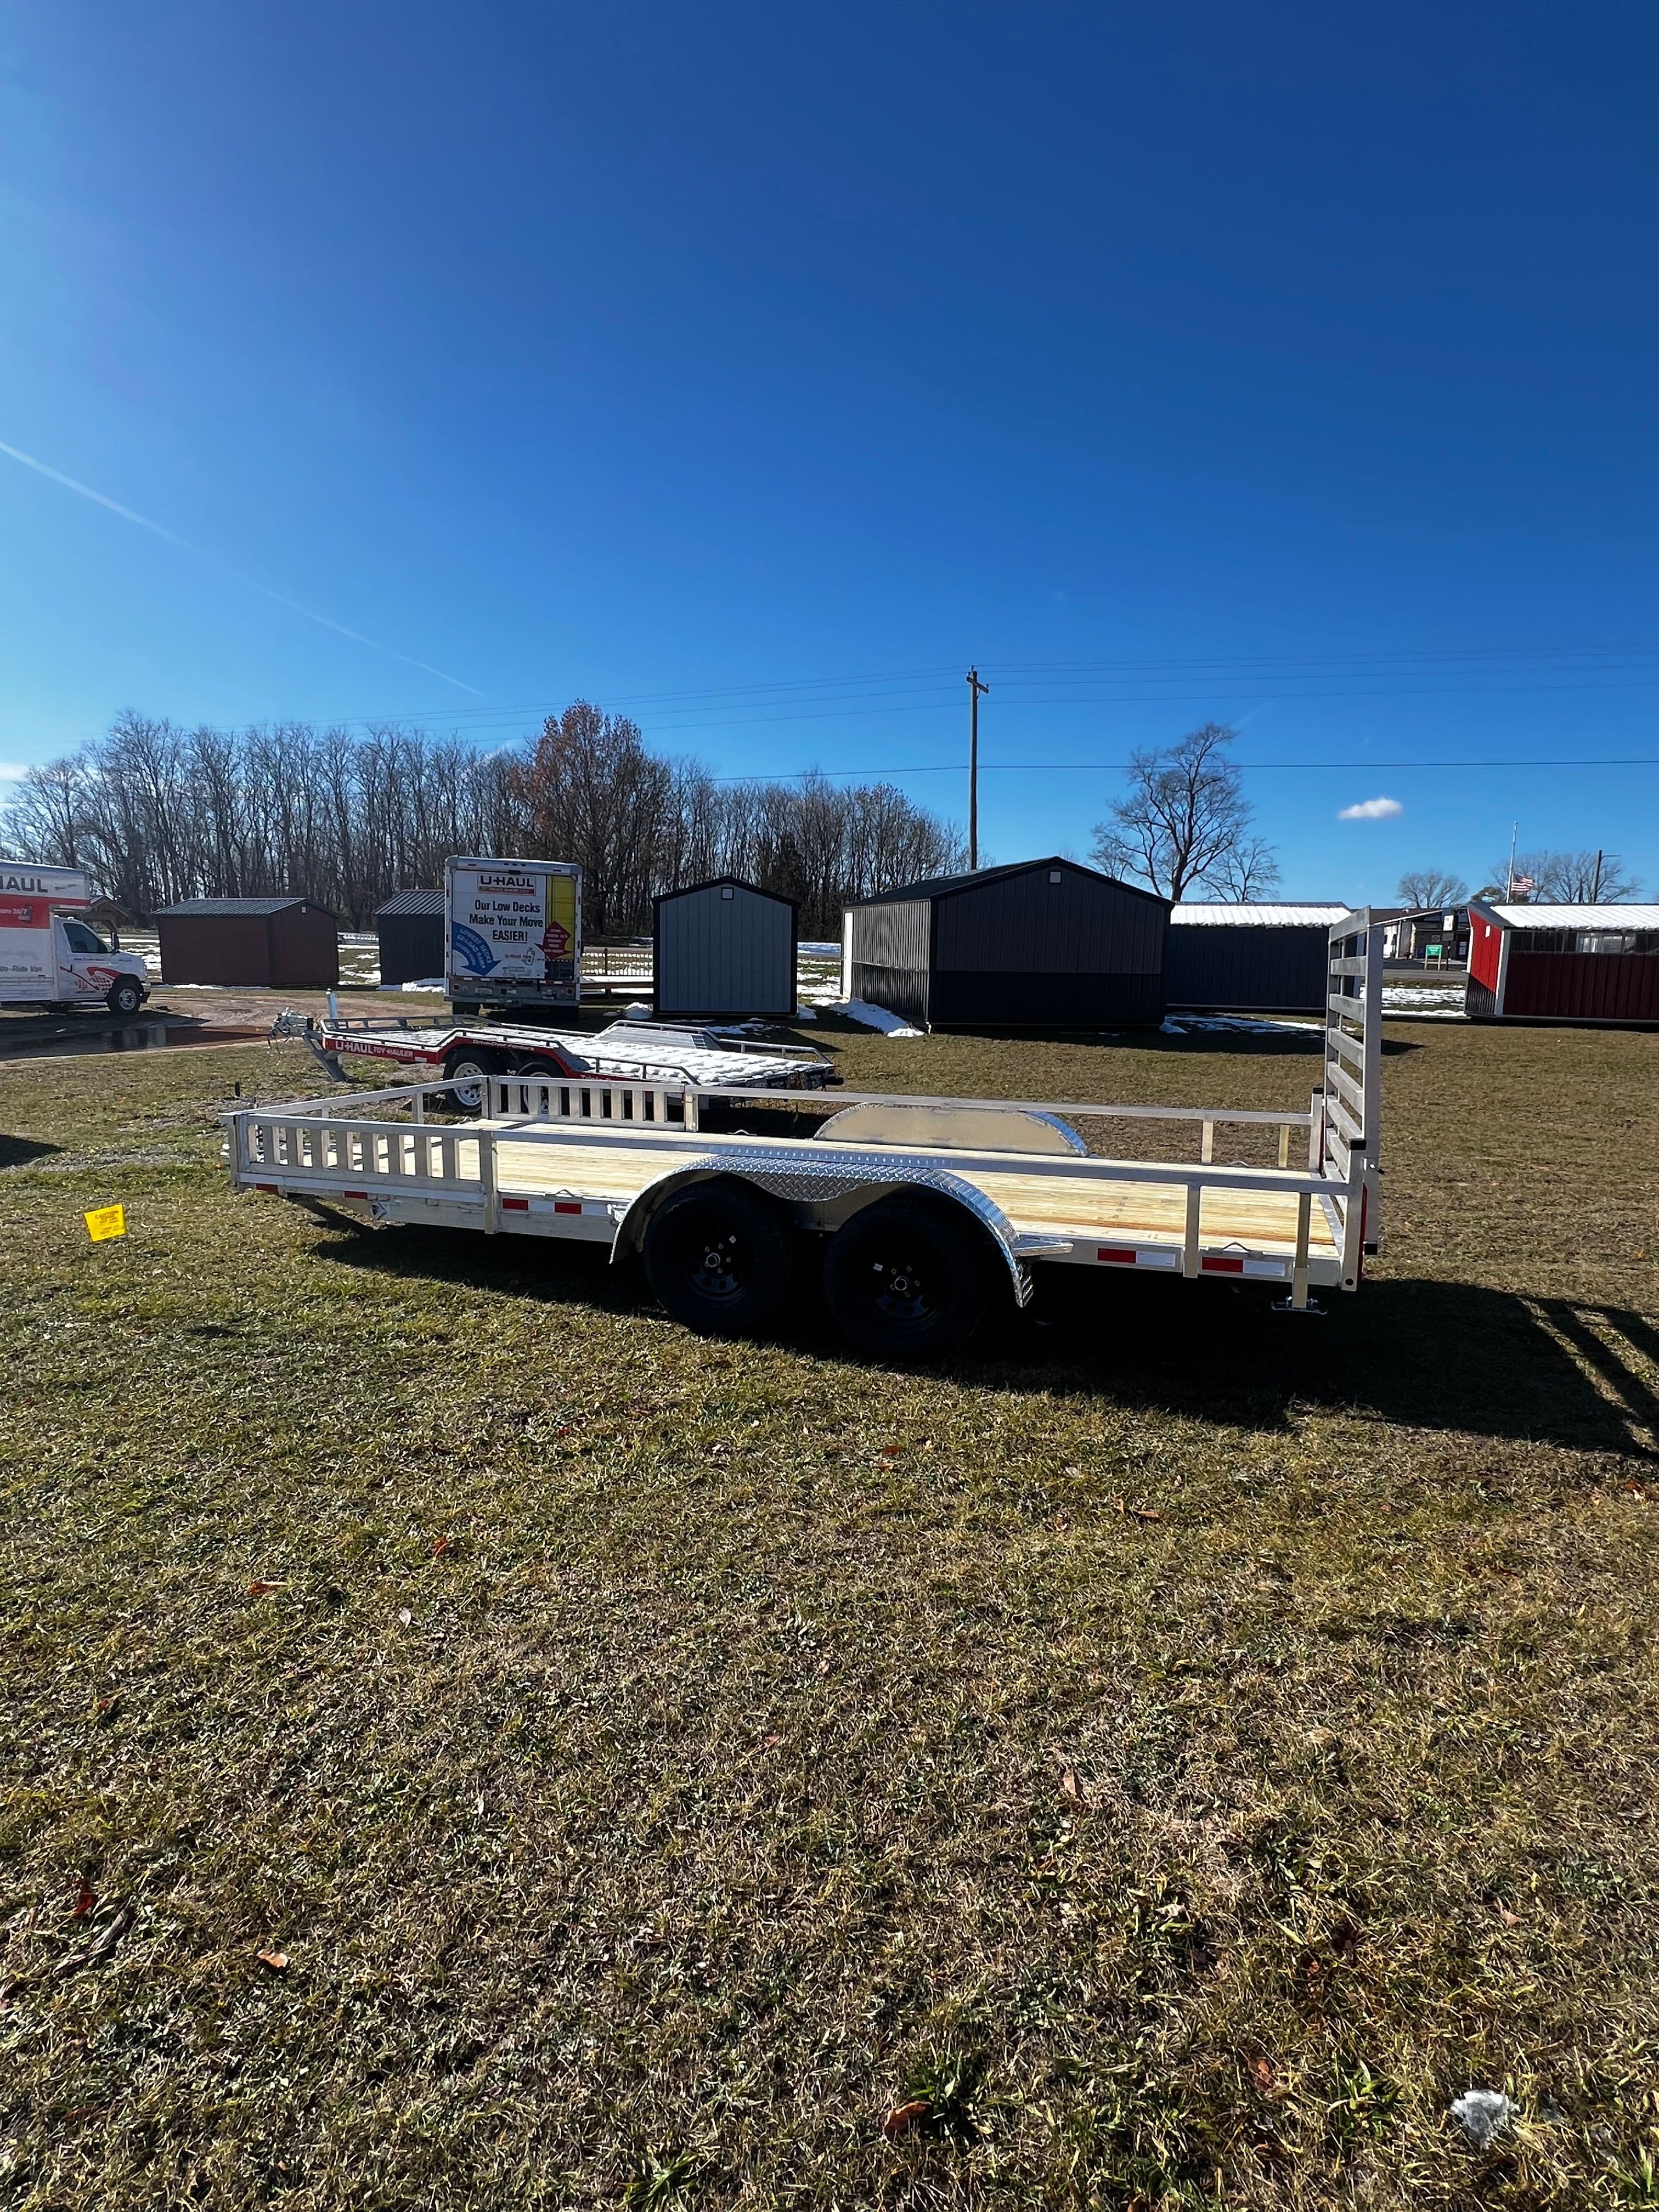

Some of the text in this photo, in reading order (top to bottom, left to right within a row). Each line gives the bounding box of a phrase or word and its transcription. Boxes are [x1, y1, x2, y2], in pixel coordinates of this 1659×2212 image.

[0, 876, 48, 893] AUL
[480, 875, 534, 888] U-HAUL
[475, 899, 541, 913] Our Low Decks
[469, 913, 544, 927] Make Your Move
[492, 929, 528, 941] EASIER!
[335, 1040, 374, 1054] U-HAUL
